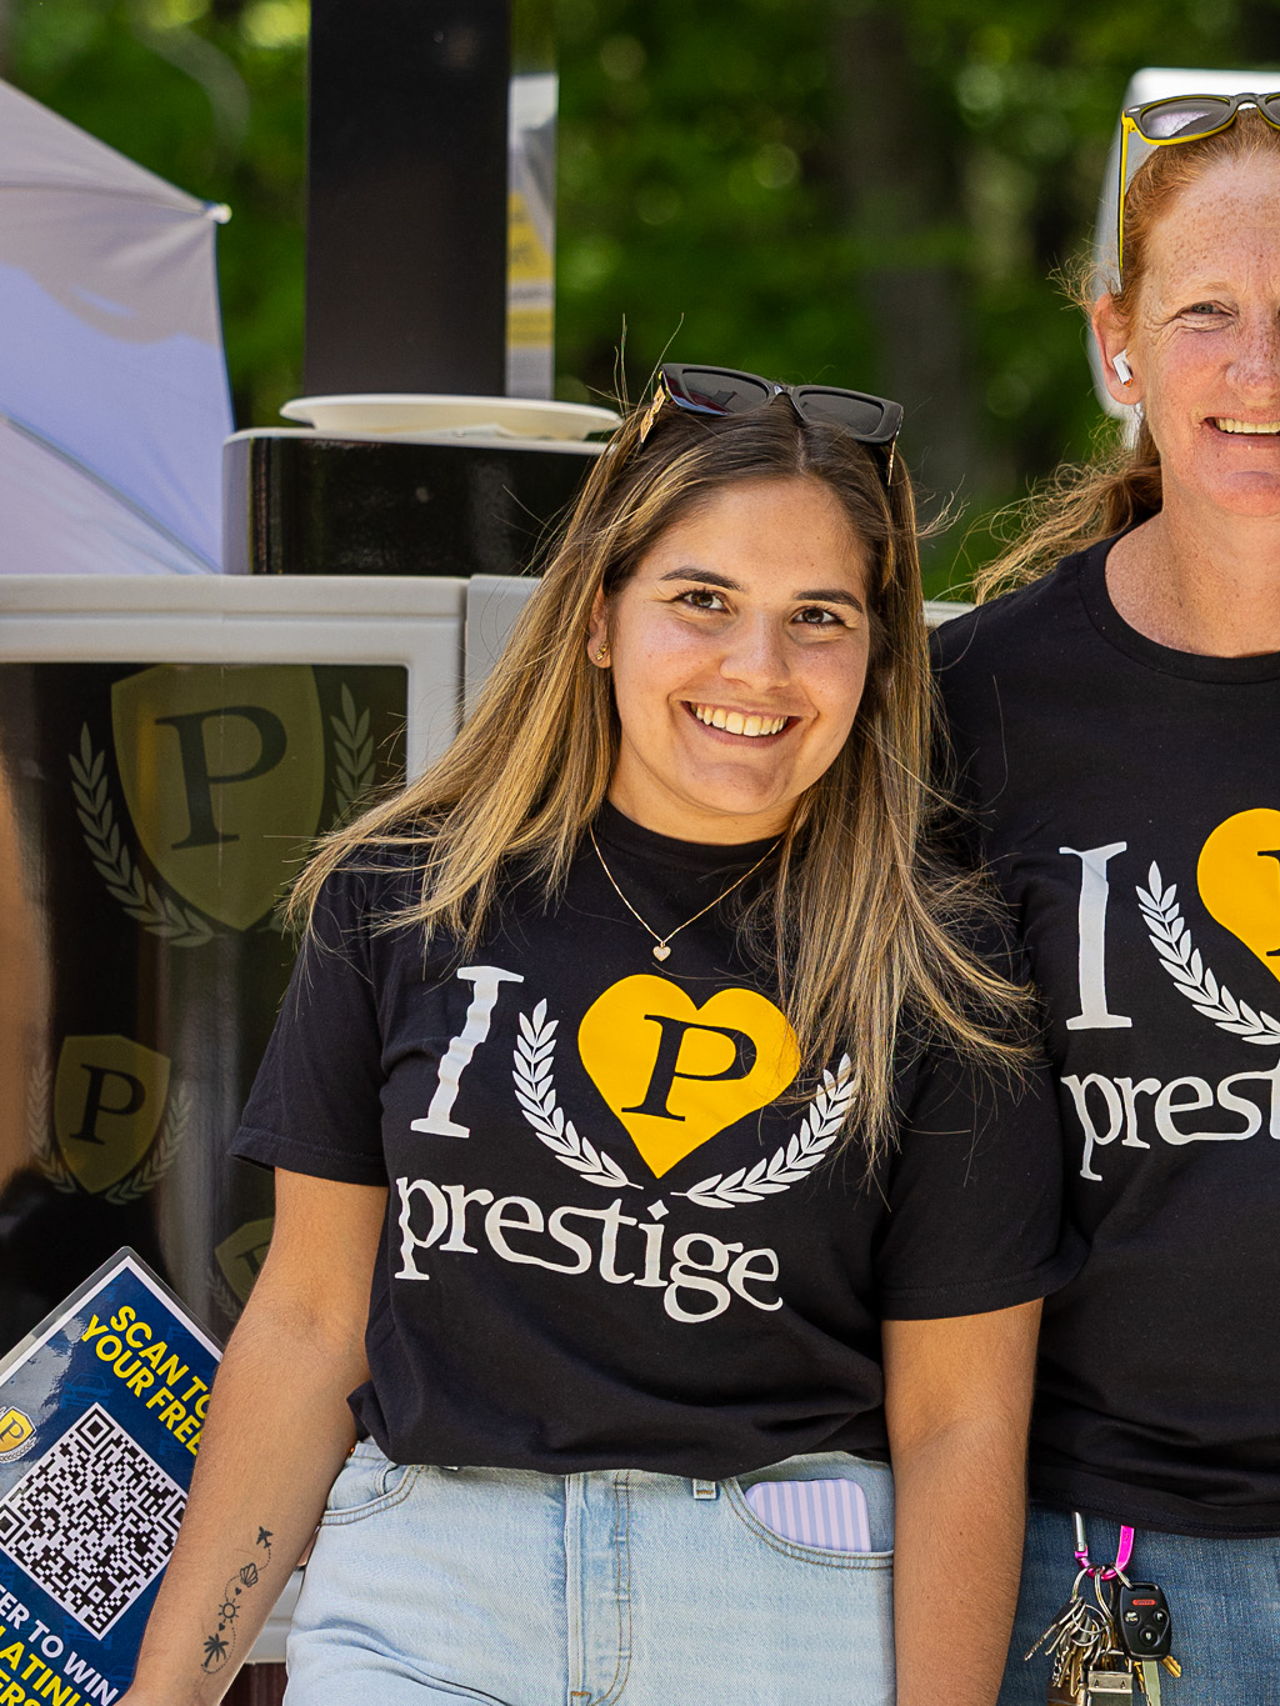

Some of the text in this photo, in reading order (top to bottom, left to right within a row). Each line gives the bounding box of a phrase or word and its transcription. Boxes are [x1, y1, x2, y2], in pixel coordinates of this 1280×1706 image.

[155, 704, 288, 851] P
[1059, 841, 1133, 1030] I
[69, 1062, 147, 1146] P
[410, 965, 758, 1139] I P
[394, 1177, 784, 1324] prestige
[80, 1314, 155, 1398] YOUR
[110, 1305, 190, 1387] SCAN
[0, 1417, 25, 1443] P
[0, 1584, 30, 1630] ER
[28, 1619, 64, 1658] TO
[63, 1651, 119, 1706] WIN
